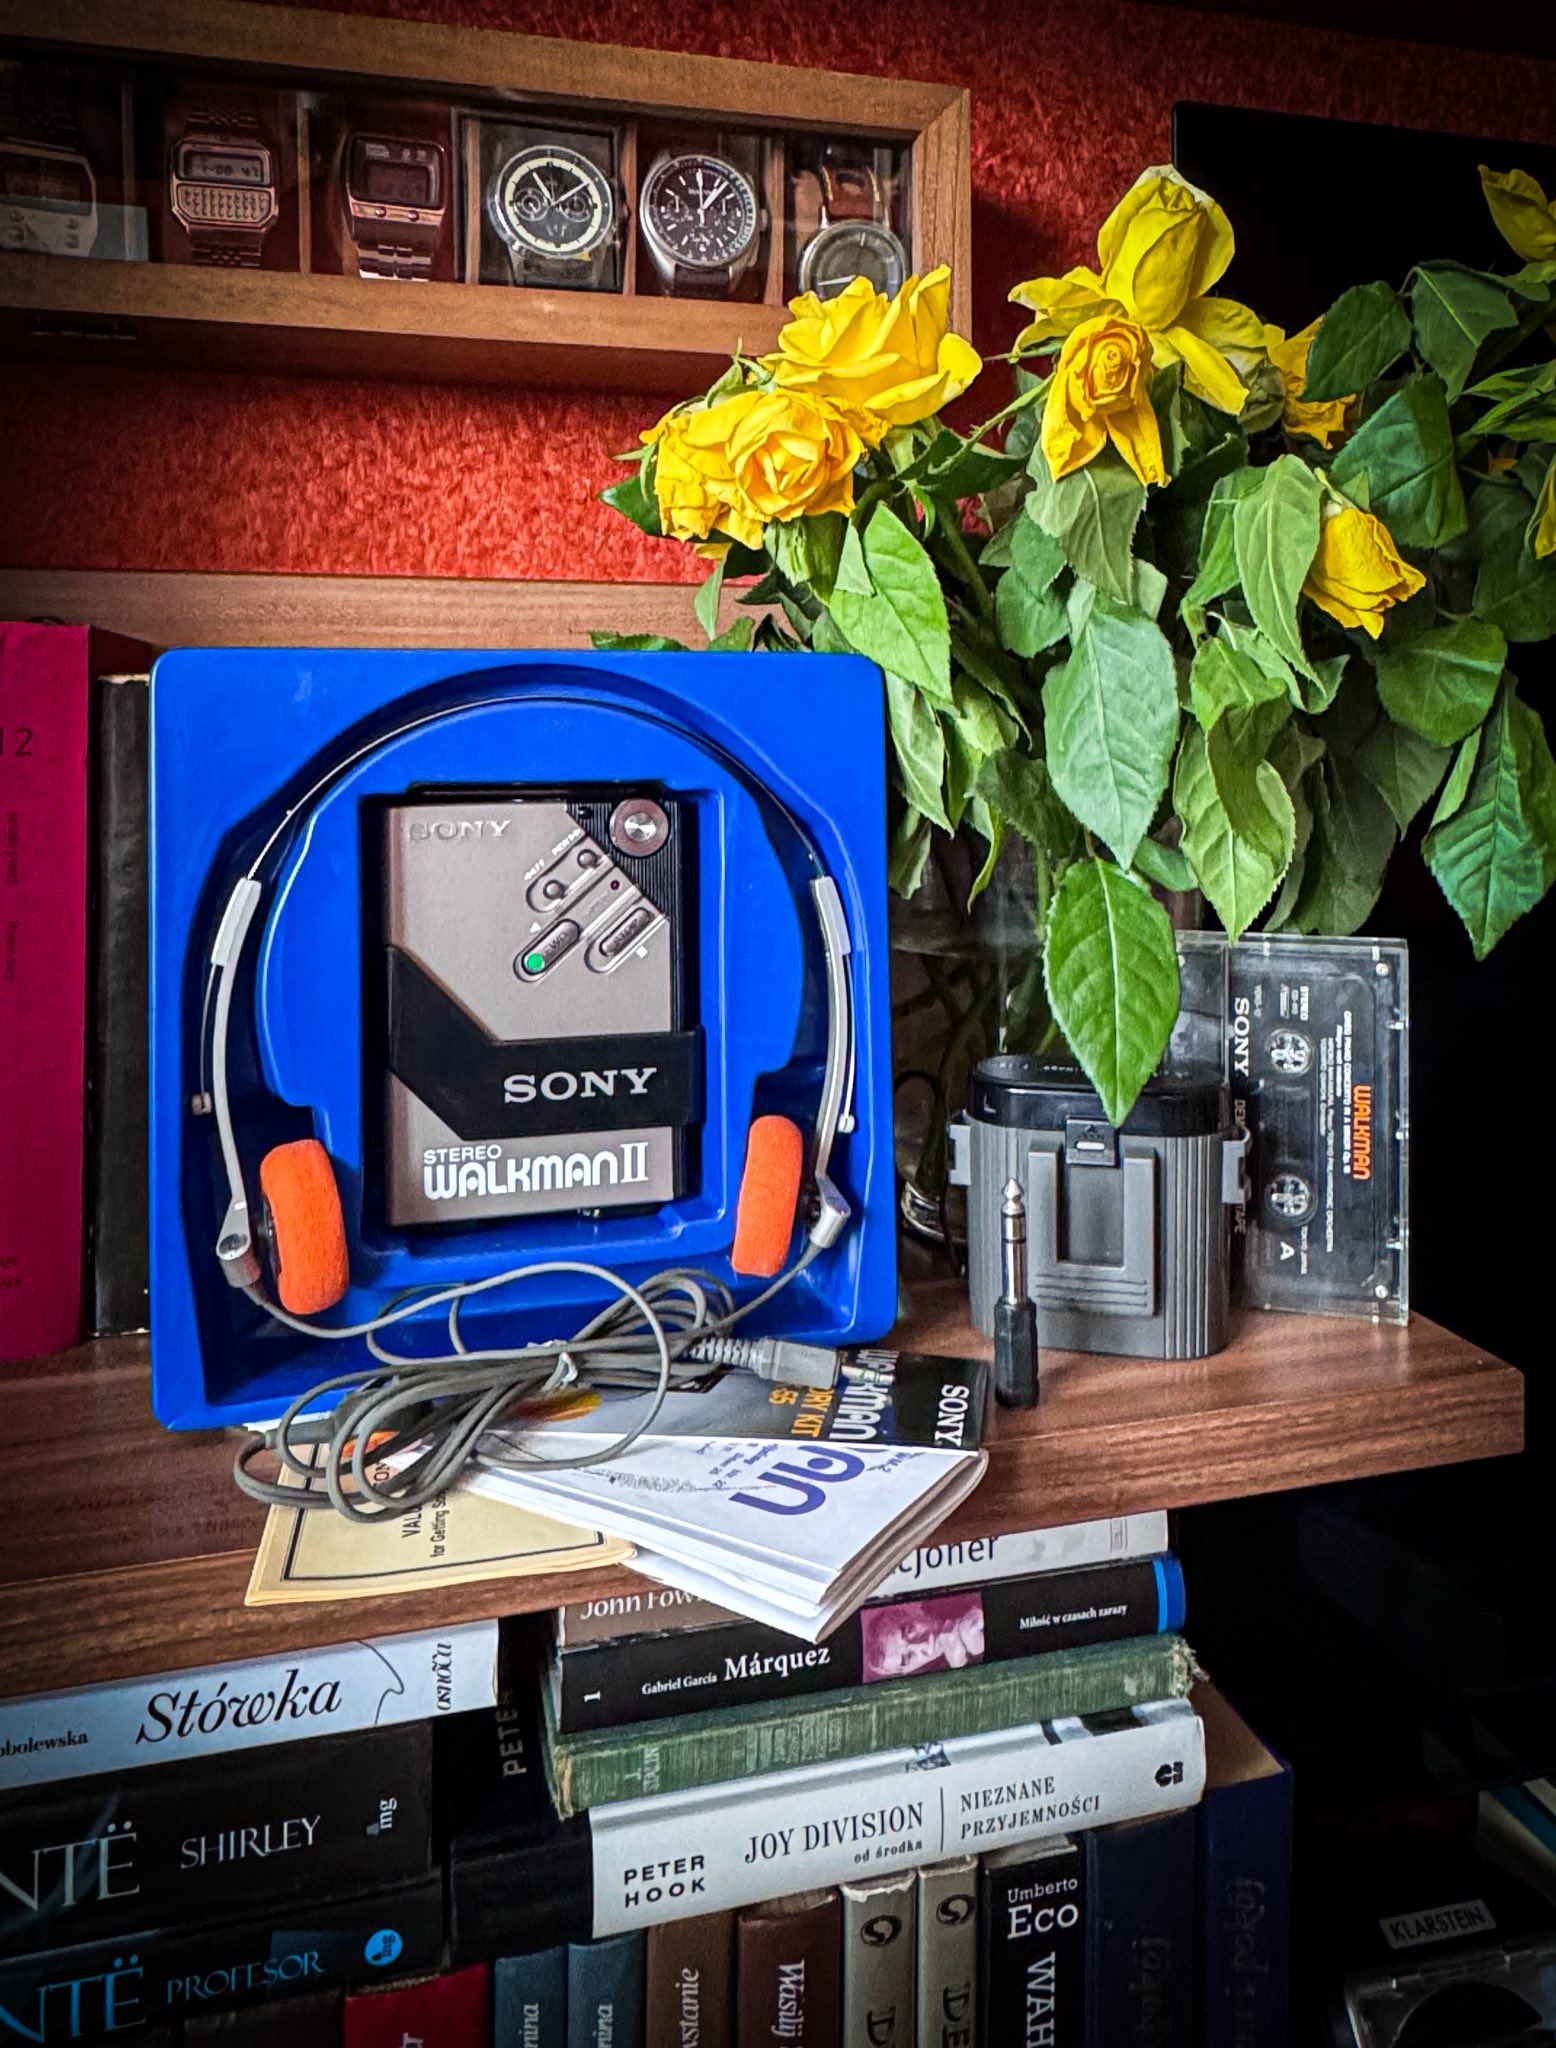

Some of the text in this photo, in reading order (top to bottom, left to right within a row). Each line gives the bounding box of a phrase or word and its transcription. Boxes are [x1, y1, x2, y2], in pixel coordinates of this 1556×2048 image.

[409, 820, 511, 842] SONY
[1234, 997, 1250, 1077] SONY
[504, 1066, 657, 1104] SONY
[1353, 1085, 1371, 1180] WALKMAN
[424, 1144, 502, 1165] STEREO
[1280, 1241, 1295, 1261] A
[791, 1412, 827, 1438] KIT
[934, 1384, 970, 1447] SONY
[429, 1508, 451, 1543] Getting
[893, 1535, 999, 1579] cjoner
[1098, 1604, 1129, 1619] zarazy
[641, 1643, 832, 1697] Gabriel García Márquez
[135, 1669, 341, 1746] Stówka
[959, 1776, 1056, 1812] NIEZNANE
[744, 1802, 923, 1864] JOY DIVISION
[959, 1793, 1101, 1841] PRZYJEMNOŚCI
[180, 1814, 322, 1870] SHIRLEY
[854, 1838, 924, 1864] od środka
[623, 1854, 707, 1887] PETER
[624, 1876, 707, 1909] HOOK
[1007, 1876, 1079, 1904] Umberto
[1389, 1906, 1487, 1942] KLARSTEIN
[166, 1949, 326, 2004] PROFESOR
